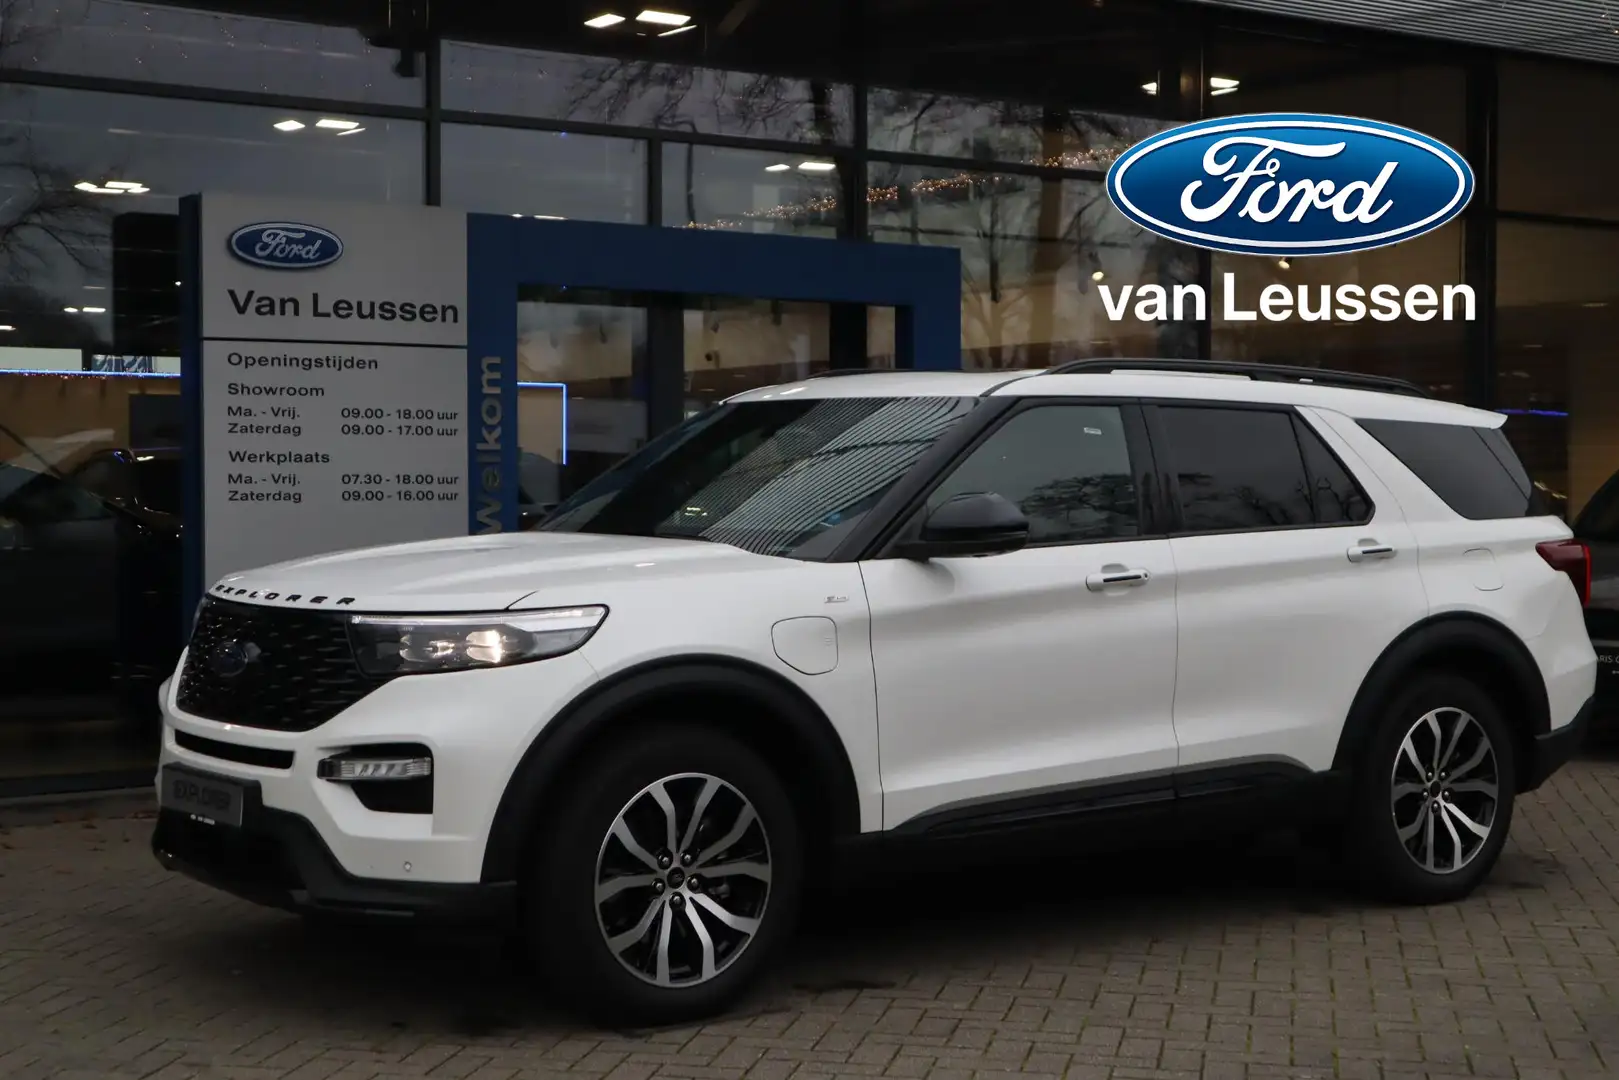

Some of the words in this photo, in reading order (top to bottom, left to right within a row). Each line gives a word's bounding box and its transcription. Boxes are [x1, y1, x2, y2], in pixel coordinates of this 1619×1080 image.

[254, 229, 322, 260] Ford
[227, 289, 300, 317] Van
[312, 292, 459, 324] Leussen
[227, 352, 378, 372] Openingstijden
[227, 382, 325, 397] Showroom
[227, 405, 257, 417] Ma.
[270, 406, 300, 420] Vrij.
[340, 407, 384, 419] 09.00
[396, 408, 434, 420] 18.00
[437, 411, 458, 421] uur
[227, 422, 302, 437] Zaterdag
[341, 424, 385, 436] 09.00
[397, 425, 434, 436] 17.00
[436, 428, 458, 437] uur
[228, 450, 330, 466] Werkplaats
[227, 473, 258, 485] Ma.
[271, 473, 301, 487] Vrij.
[341, 473, 383, 485] 07.30
[395, 473, 434, 485] 18.00
[437, 476, 459, 485] uur
[228, 490, 302, 504] Zaterdag
[341, 490, 385, 502] 09.00
[397, 490, 435, 502] 16.00
[437, 492, 459, 502] uur
[215, 584, 356, 606] EXPLORER
